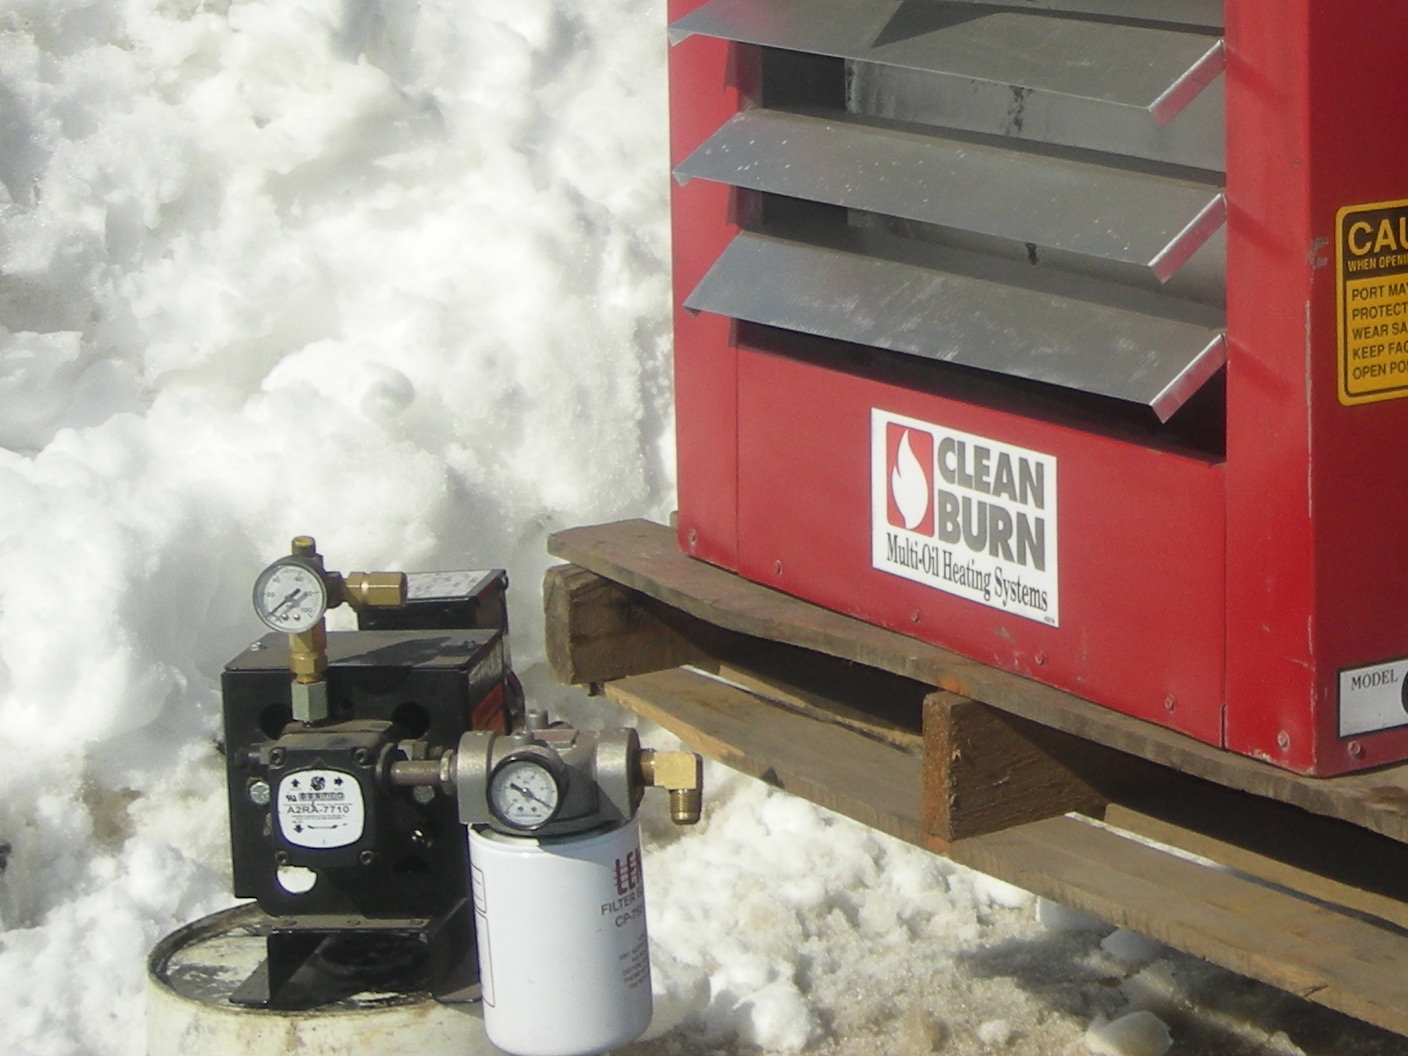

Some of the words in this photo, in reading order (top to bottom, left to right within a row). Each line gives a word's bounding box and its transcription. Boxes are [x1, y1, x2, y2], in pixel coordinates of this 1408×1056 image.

[1348, 254, 1376, 272] WHEN
[1352, 285, 1384, 301] PORT
[1352, 302, 1408, 321] PROTECT
[1352, 324, 1388, 341] WEAR
[1353, 344, 1384, 360] KEEP
[1353, 364, 1386, 380] OPEN
[938, 437, 1044, 510] CLEAN
[938, 488, 1045, 572] BURN
[886, 532, 939, 577] Multi-Oil
[943, 550, 991, 602] Heating
[995, 566, 1048, 612] Systems
[1351, 669, 1398, 691] MODEL
[287, 805, 350, 814] A2RA-7710
[601, 891, 636, 916] FILTER
